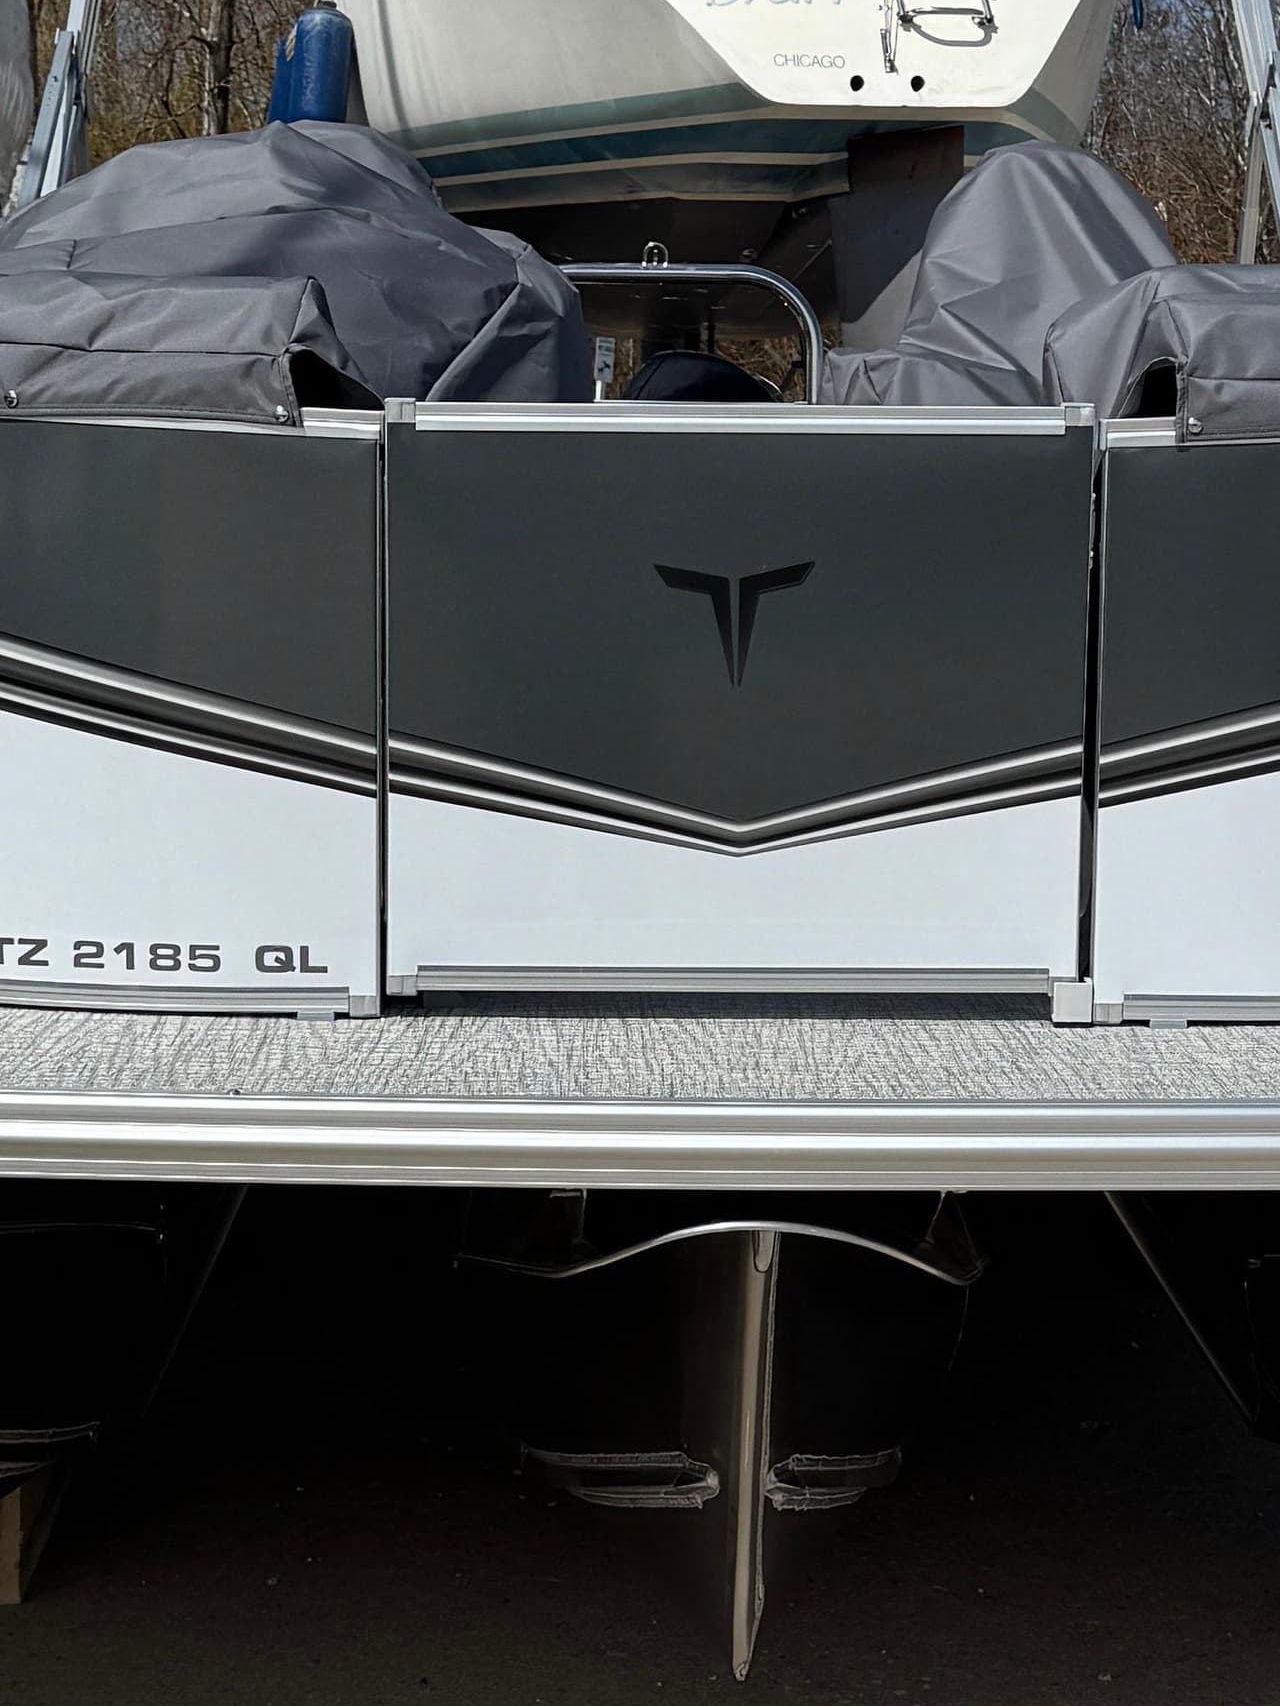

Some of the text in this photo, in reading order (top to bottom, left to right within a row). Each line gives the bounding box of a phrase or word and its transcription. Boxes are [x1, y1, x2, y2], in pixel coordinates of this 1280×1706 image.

[773, 53, 846, 69] CHICAGO
[72, 940, 221, 972] 2185
[255, 945, 328, 973] QL
